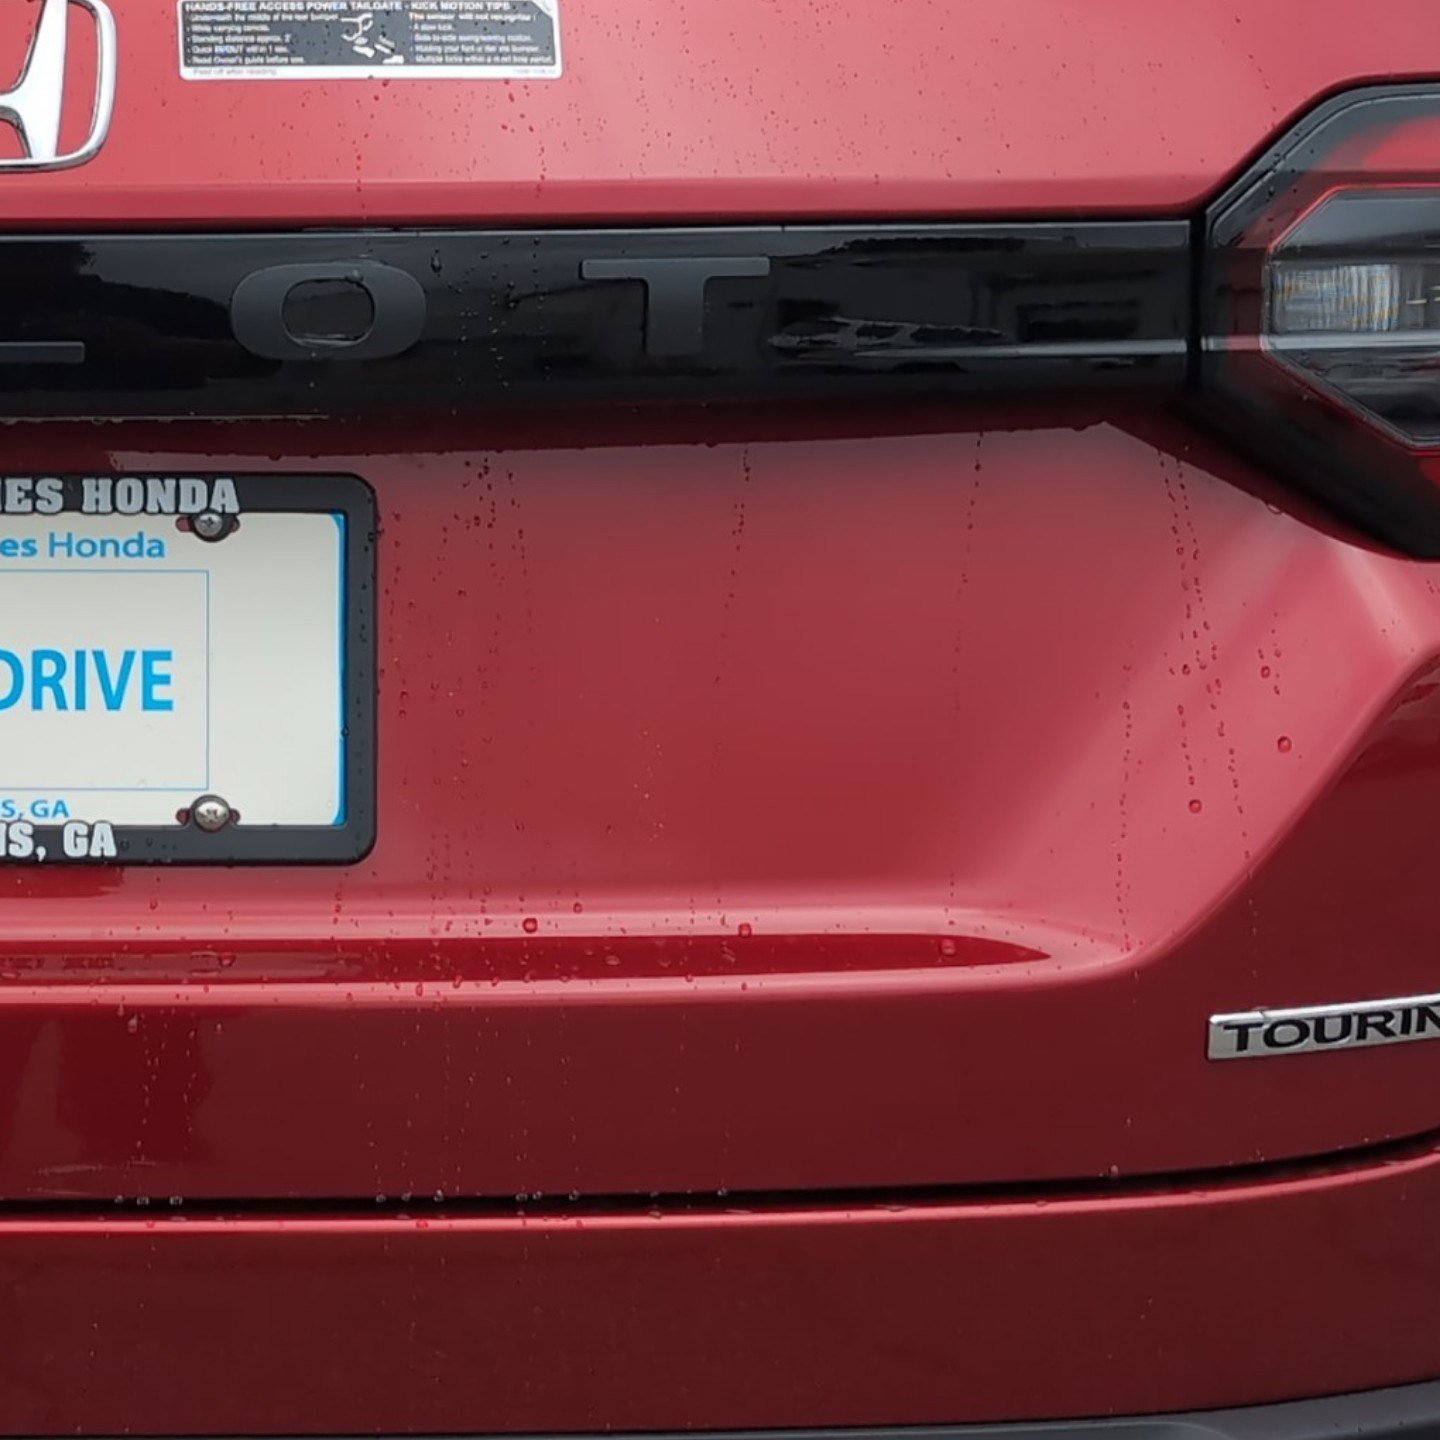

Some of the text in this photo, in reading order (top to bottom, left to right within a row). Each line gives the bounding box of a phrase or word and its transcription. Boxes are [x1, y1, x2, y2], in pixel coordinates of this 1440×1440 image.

[82, 477, 240, 514] HONDA
[49, 531, 166, 559] Honda
[30, 799, 70, 818] GA
[63, 820, 117, 858] GA
